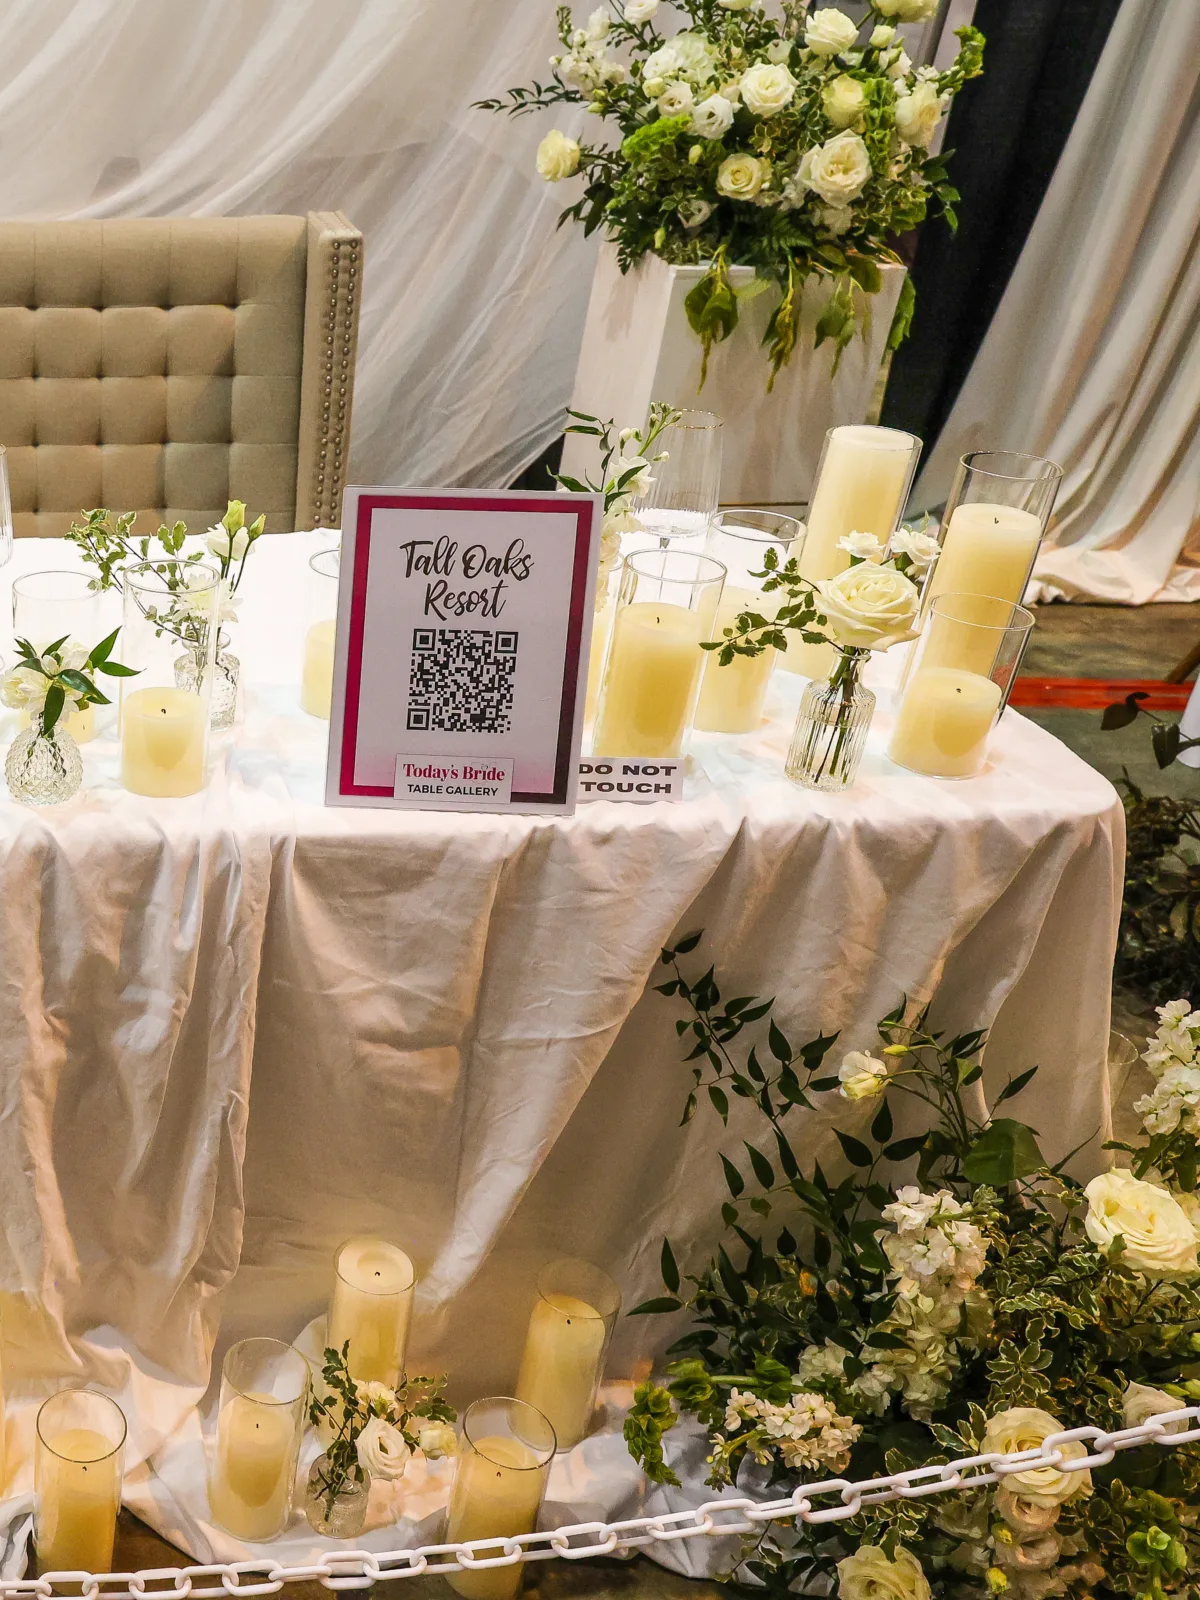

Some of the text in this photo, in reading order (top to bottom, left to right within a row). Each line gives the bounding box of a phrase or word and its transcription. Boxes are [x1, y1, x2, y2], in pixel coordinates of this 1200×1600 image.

[399, 535, 535, 581] Tall Oaks
[423, 579, 509, 622] Resort
[402, 762, 505, 782] Today's Bride
[579, 763, 677, 776] DO NOT
[407, 783, 499, 797] TABLE GALLERY
[580, 781, 672, 794] TOUCH
